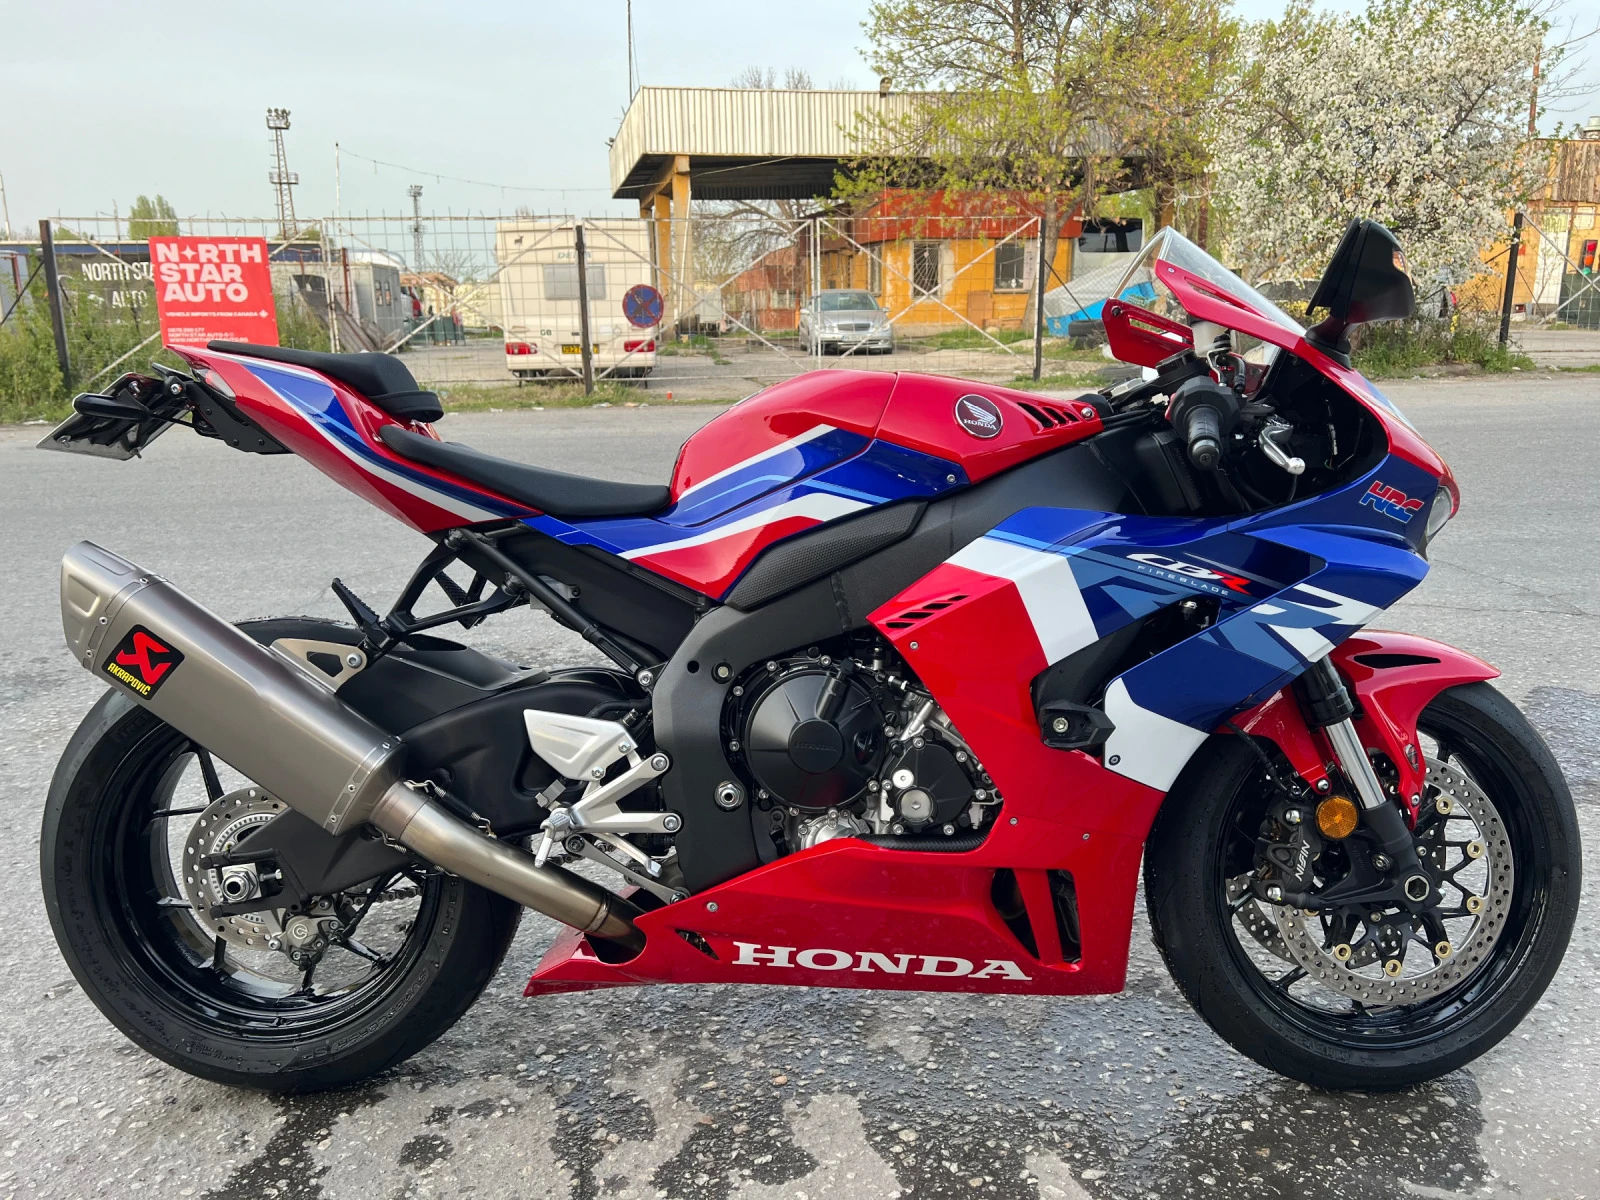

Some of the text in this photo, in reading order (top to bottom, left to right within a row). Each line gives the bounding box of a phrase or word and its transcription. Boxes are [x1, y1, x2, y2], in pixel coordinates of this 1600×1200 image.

[81, 262, 130, 281] NORTH
[159, 262, 244, 282] STAR
[163, 282, 249, 303] AUTO
[540, 328, 552, 336] GB
[963, 418, 997, 430] HONDA
[1358, 480, 1425, 524] HRC
[1137, 565, 1230, 596] FIREBLADE
[732, 941, 1033, 981] HONDA
